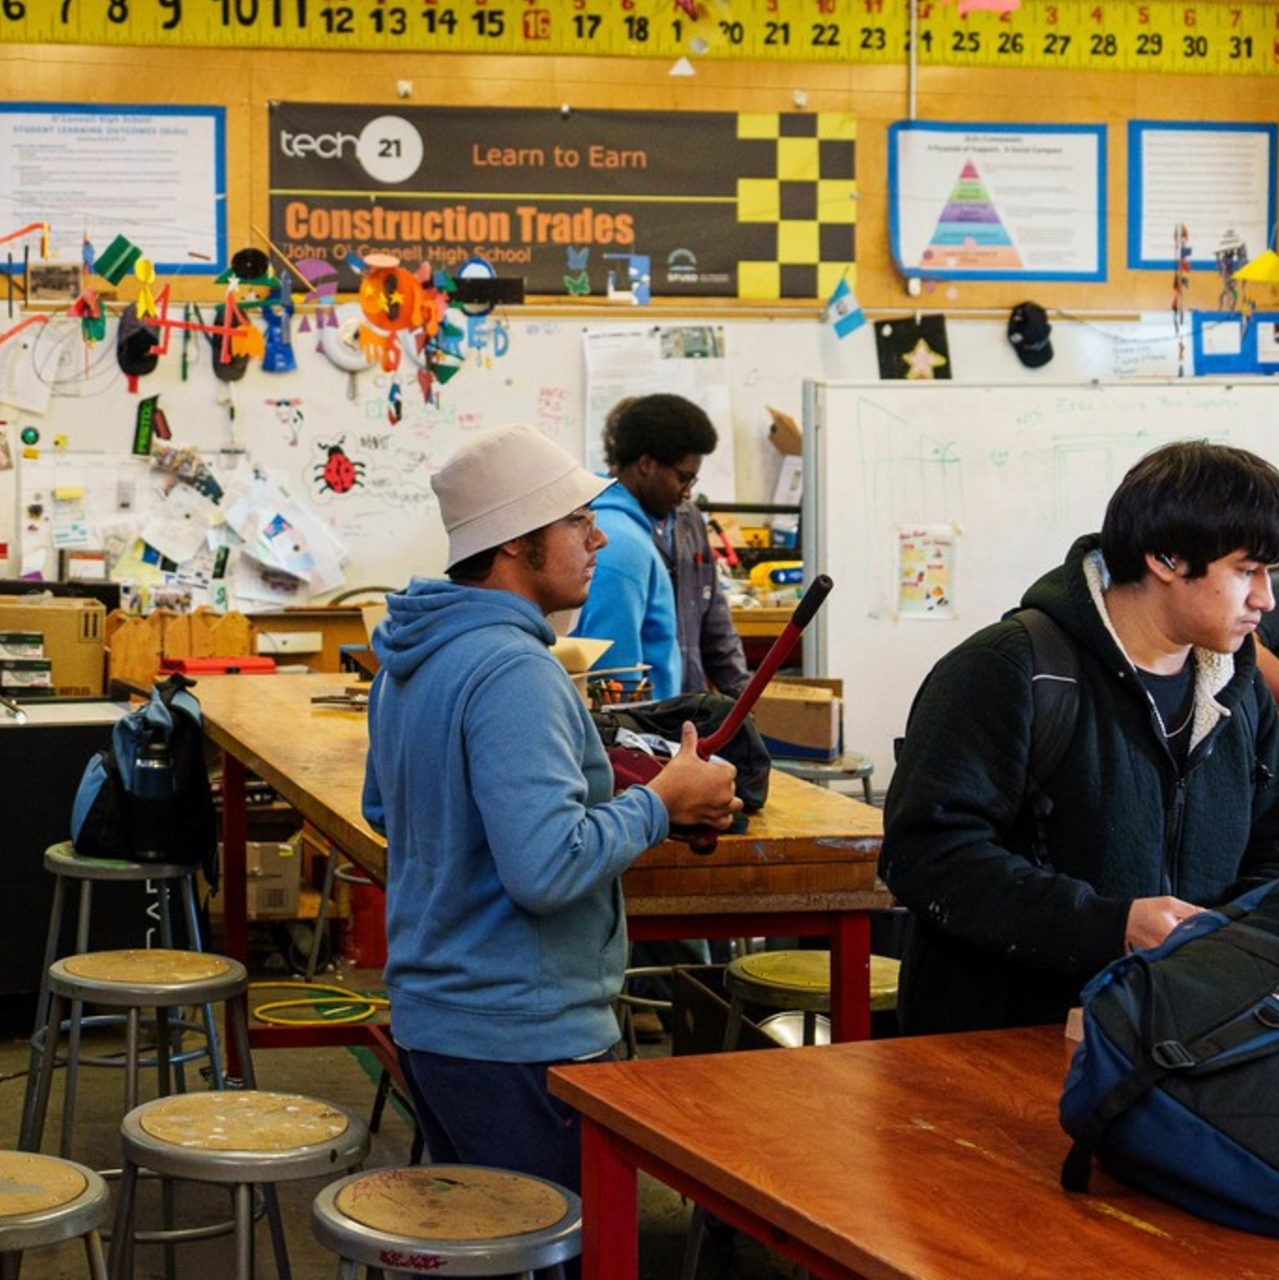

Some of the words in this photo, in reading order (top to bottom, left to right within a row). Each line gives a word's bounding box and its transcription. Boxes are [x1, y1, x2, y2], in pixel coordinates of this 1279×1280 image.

[1046, 6, 1058, 25] 3
[1090, 6, 1103, 25] 4
[1138, 7, 1150, 25] 5
[1184, 8, 1196, 27] 6
[1229, 10, 1241, 28] 7
[319, 7, 355, 34] 12
[369, 8, 407, 36] 13
[421, 9, 458, 36] 14
[471, 10, 505, 38] 15
[523, 10, 551, 39] 16
[572, 15, 602, 39] 17
[624, 17, 649, 42] 18
[764, 22, 790, 46] 21
[811, 23, 840, 47] 22
[860, 26, 886, 51] 23
[951, 31, 980, 53] 25
[997, 32, 1024, 54] 26
[1043, 34, 1071, 56] 27
[1090, 34, 1118, 57] 28
[1136, 34, 1163, 56] 29
[1183, 36, 1208, 59] 30
[1229, 36, 1254, 59] 31
[281, 130, 359, 159] tech
[378, 138, 402, 158] 21
[472, 142, 545, 168] Learn
[553, 144, 581, 168] to
[589, 145, 648, 169] Earn
[285, 202, 510, 243] Construction
[516, 207, 635, 245] Trades
[283, 243, 329, 261] John
[427, 246, 468, 266] High
[473, 246, 532, 264] School
